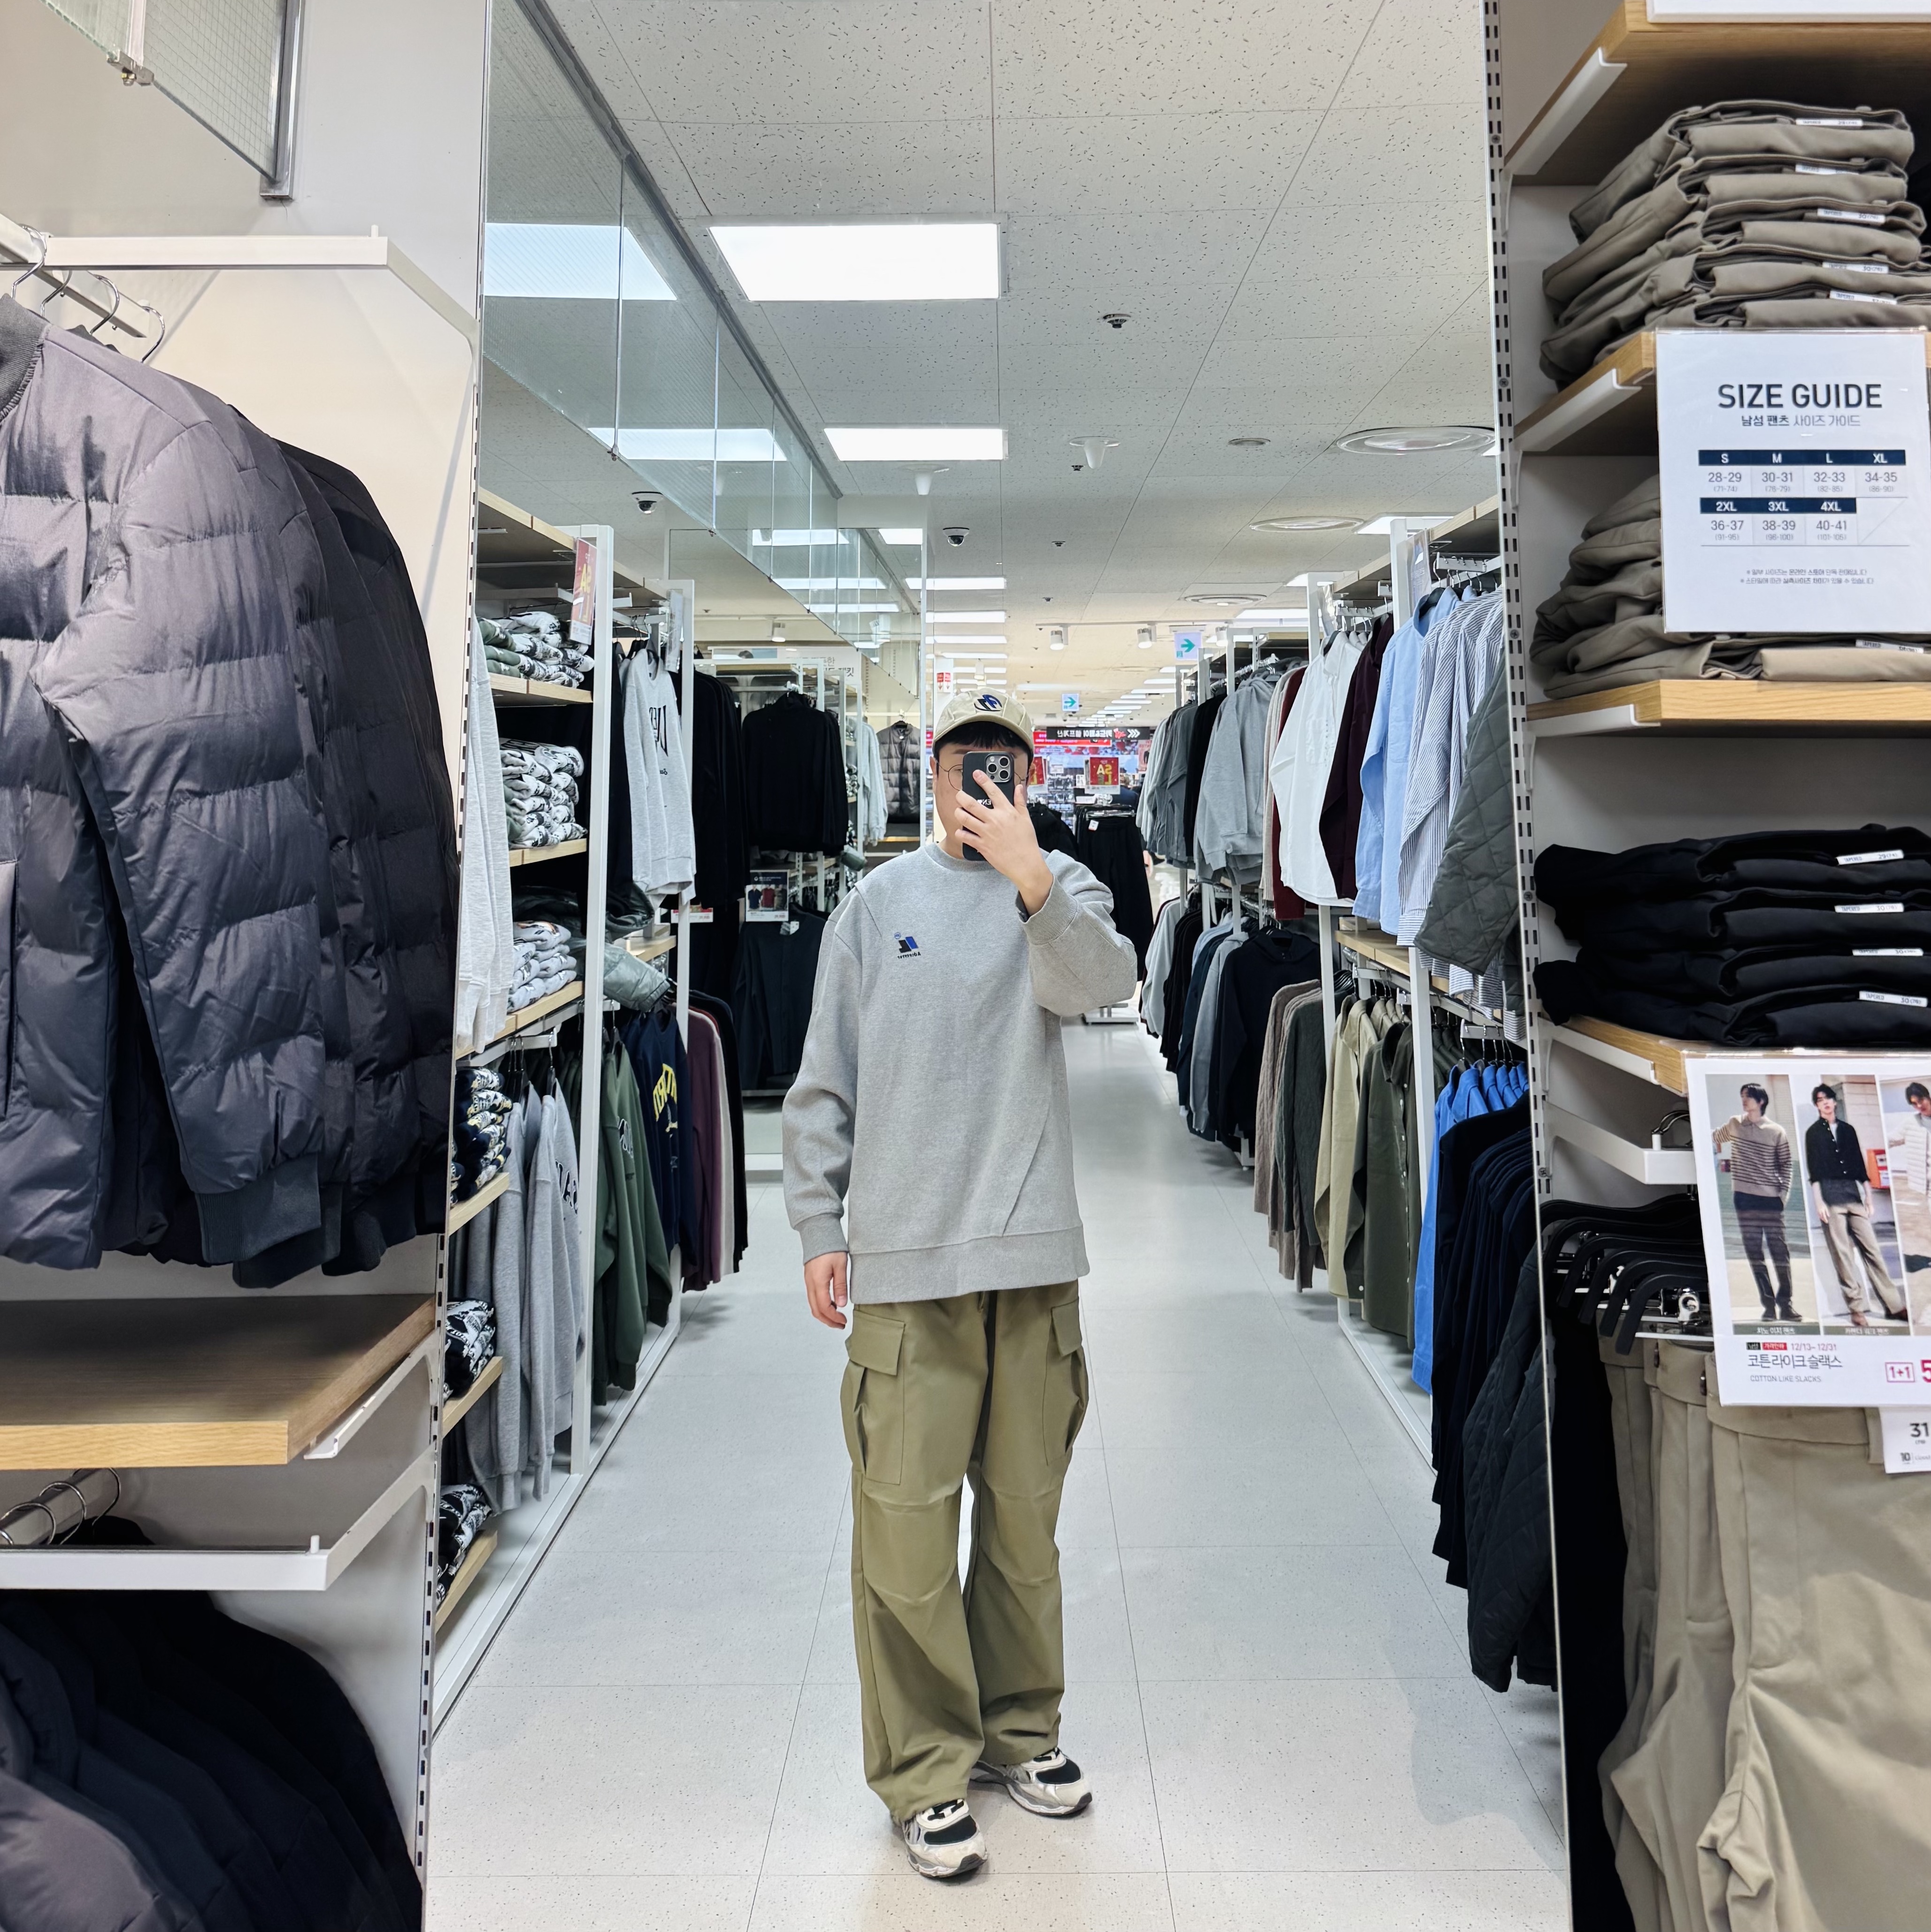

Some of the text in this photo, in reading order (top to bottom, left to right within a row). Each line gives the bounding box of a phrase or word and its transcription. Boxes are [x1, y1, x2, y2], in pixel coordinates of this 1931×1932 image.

[1718, 384, 1882, 408] SIZE GUIDE
[1741, 416, 1861, 426] 남성 팬츠 사이즈 가이드
[1721, 454, 1729, 463] S
[1772, 454, 1782, 463] M
[1826, 454, 1833, 463] L
[1873, 454, 1888, 463] XL
[1708, 472, 1742, 483] 28-29
[1762, 472, 1793, 483] 30-31
[1813, 472, 1846, 483] 32-33
[1865, 472, 1898, 483] 34-35
[1716, 501, 1738, 511] 2XL
[1768, 501, 1790, 511] 3XL
[1820, 501, 1842, 511] 4XL
[1710, 520, 1744, 531] 36-37
[1762, 520, 1796, 531] 38-39
[1816, 520, 1847, 531] 40-41
[1890, 1366, 1911, 1379] 1+1
[1909, 1423, 1929, 1438] 31
